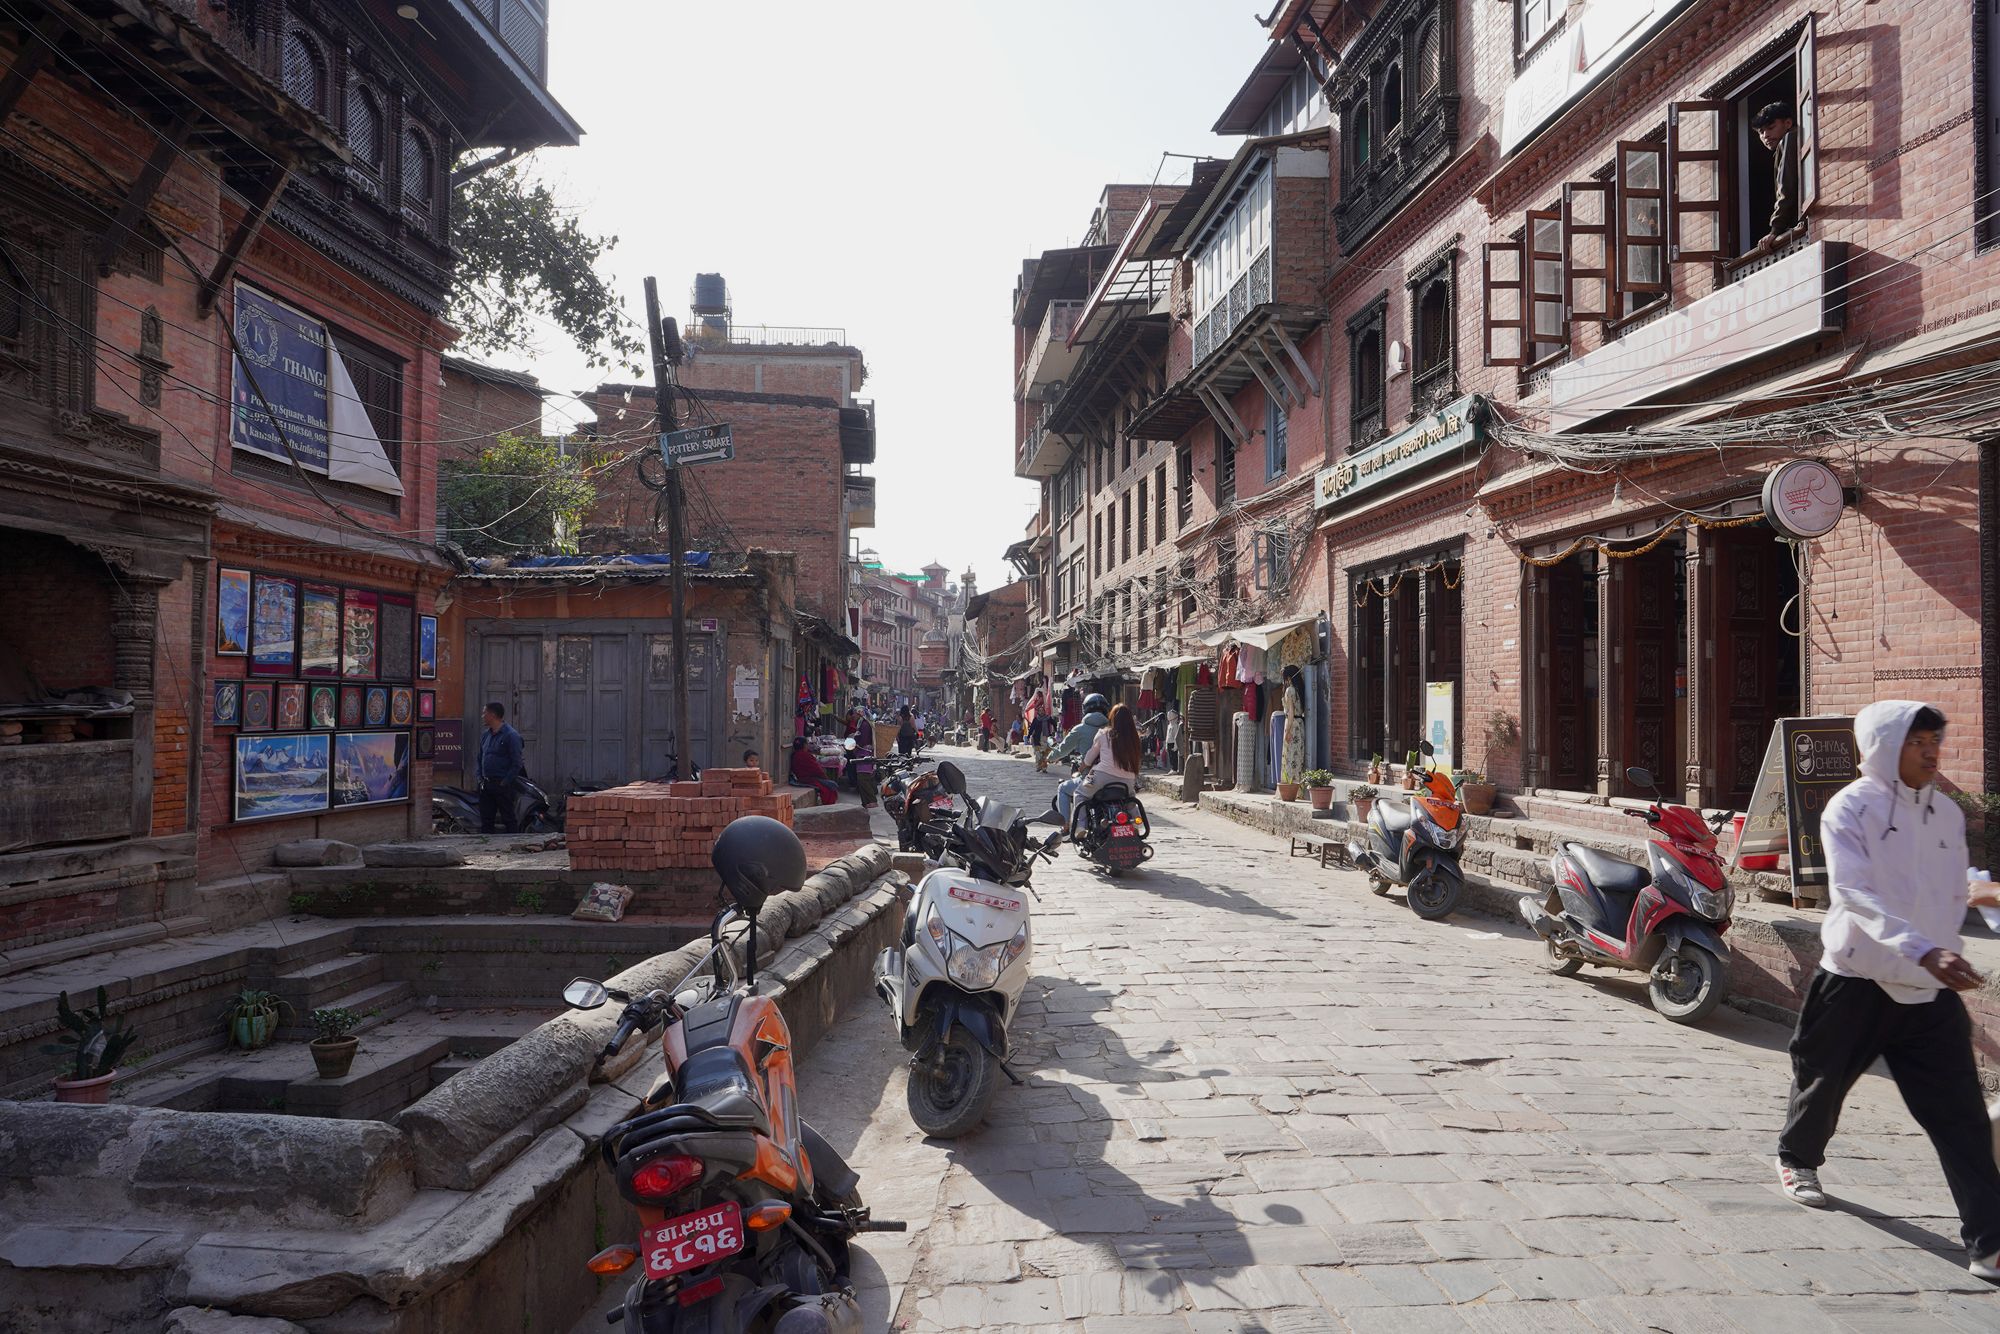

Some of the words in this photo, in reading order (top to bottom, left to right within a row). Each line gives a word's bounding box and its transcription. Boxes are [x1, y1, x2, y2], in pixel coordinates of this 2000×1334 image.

[1703, 256, 1814, 341] STORE
[254, 324, 265, 345] K
[668, 442, 700, 455] POTTERY
[702, 436, 731, 450] SQUARE
[1816, 757, 1851, 770] CHEERS
[650, 1227, 738, 1271] ६८१६
